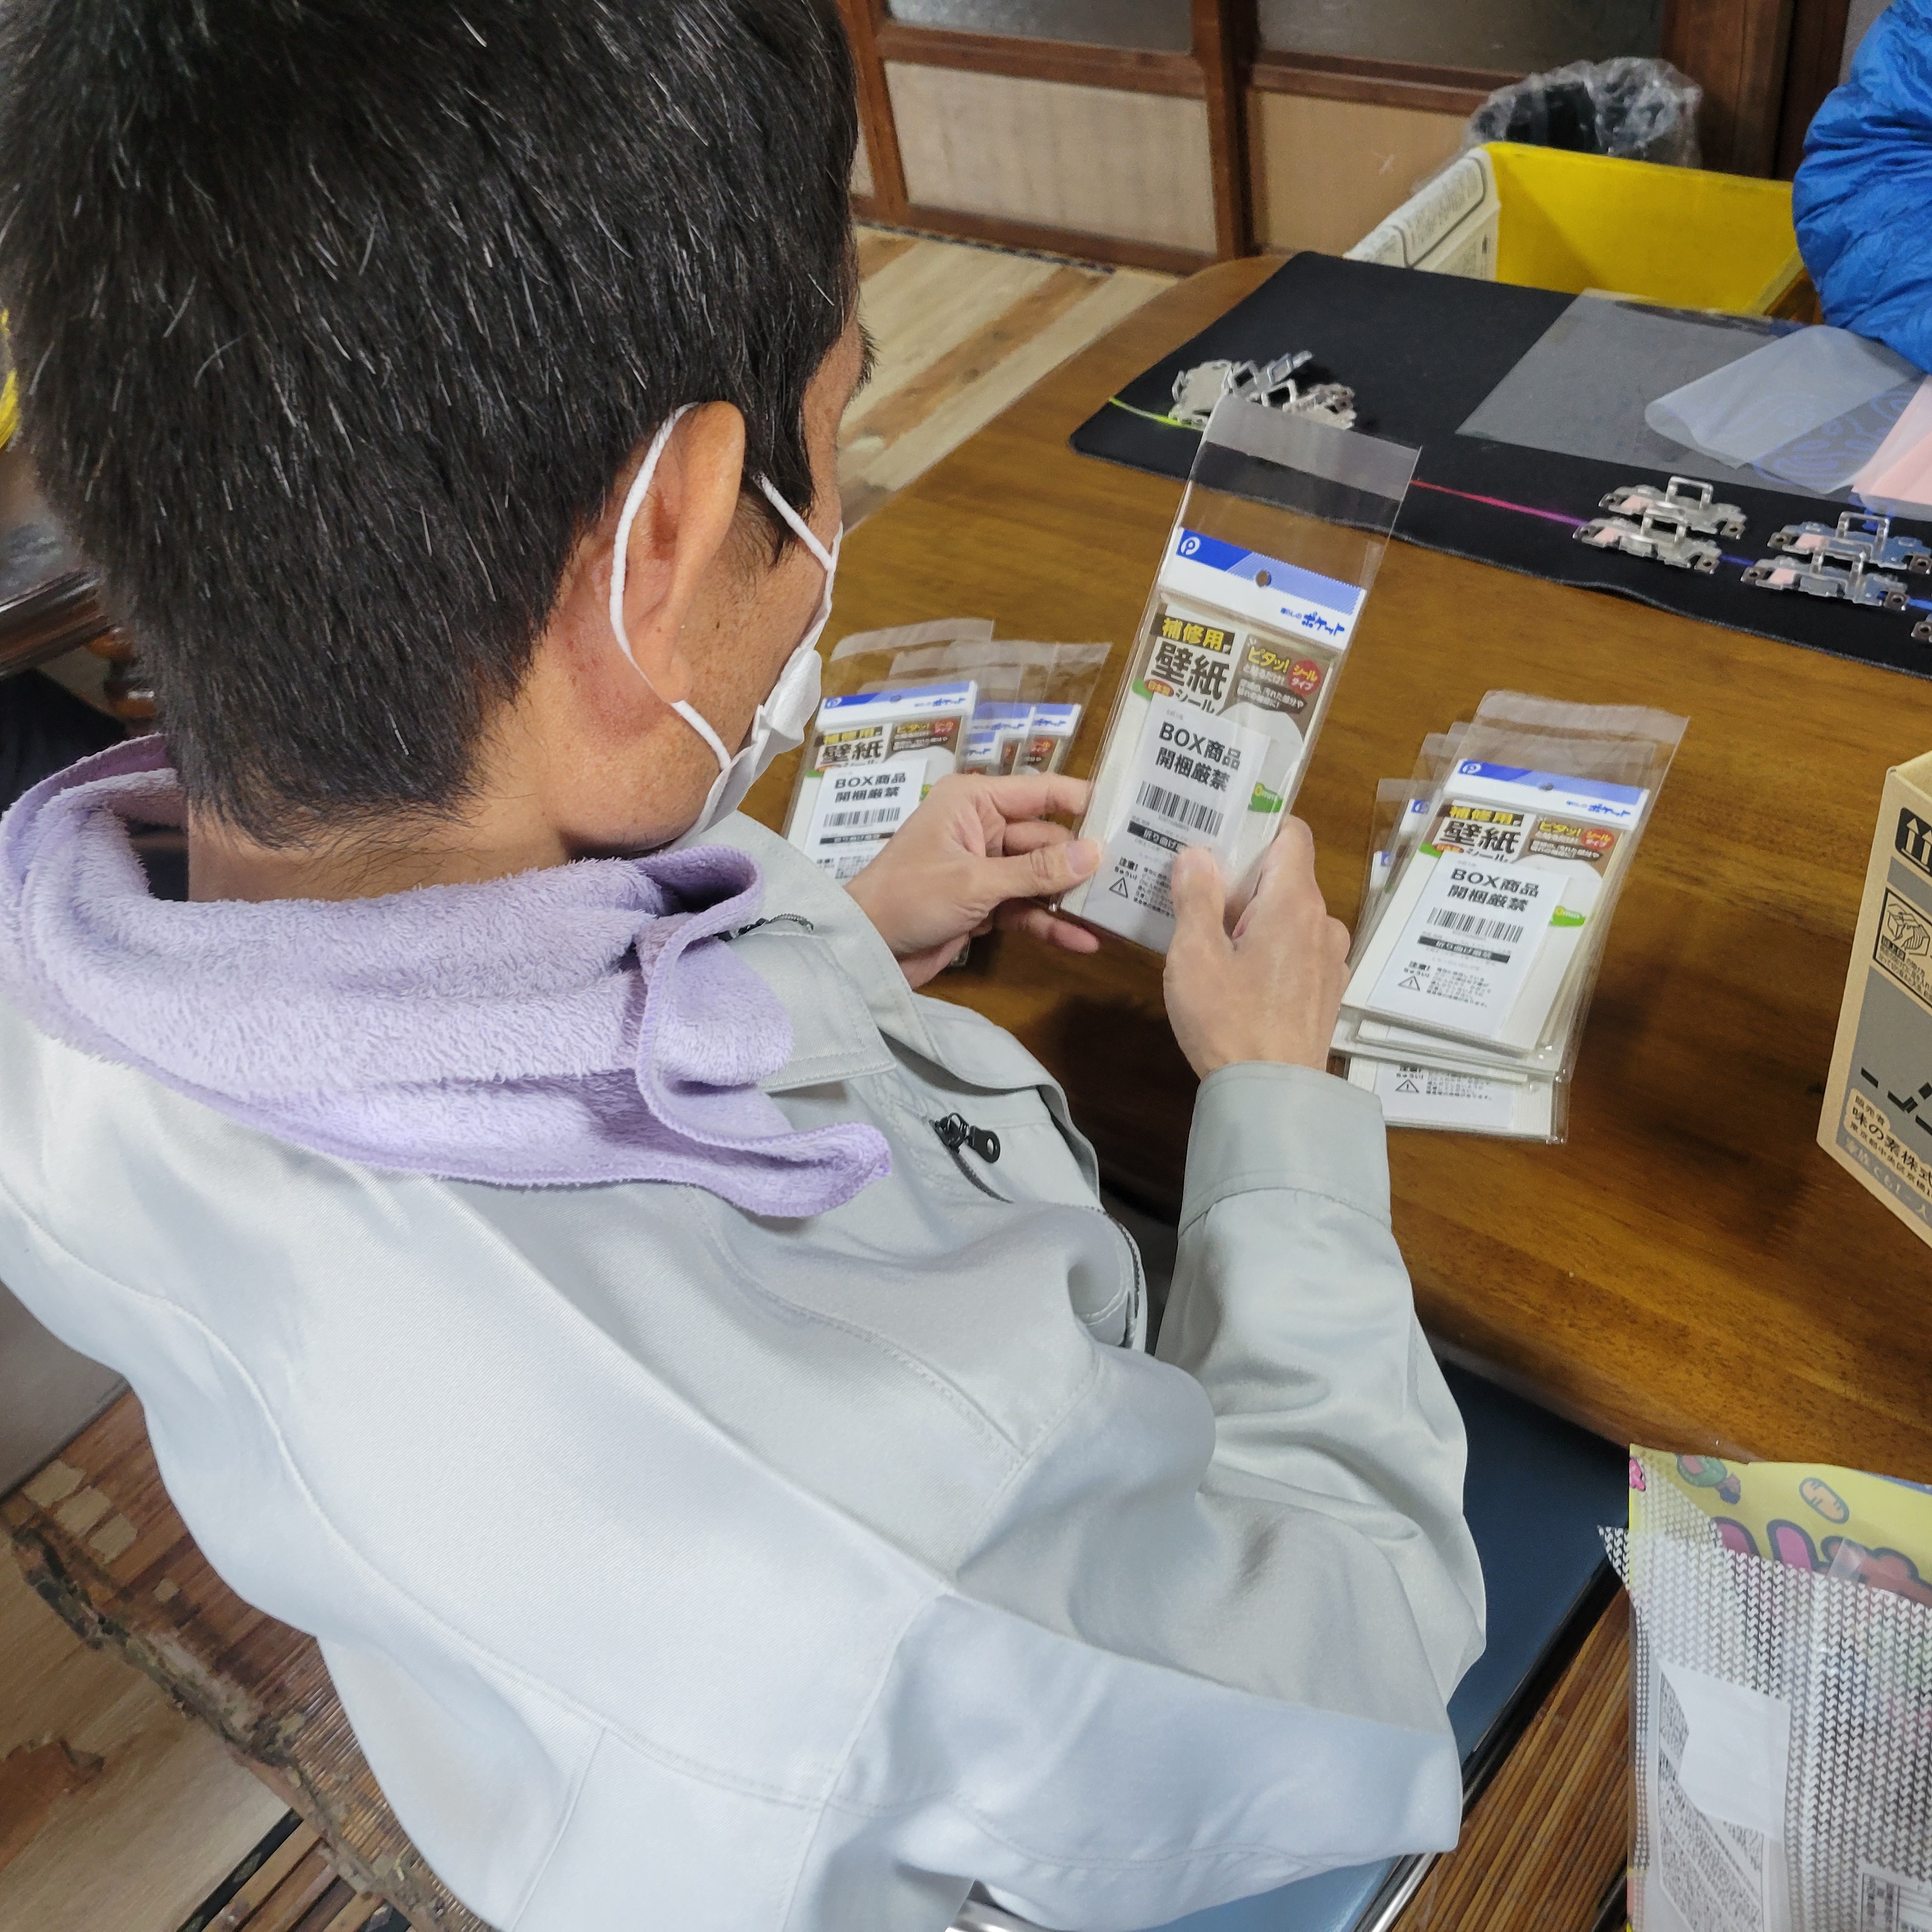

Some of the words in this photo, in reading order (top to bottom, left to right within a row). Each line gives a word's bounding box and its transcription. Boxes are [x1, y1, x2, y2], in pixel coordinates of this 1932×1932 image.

[1163, 618, 1224, 650] 補修用
[1151, 641, 1229, 700] 壁紙
[1158, 721, 1241, 770] BOX商品
[1155, 747, 1230, 792] 開梱厳禁
[1439, 820, 1521, 854] 壁紙
[1450, 868, 1539, 898] BOX商品
